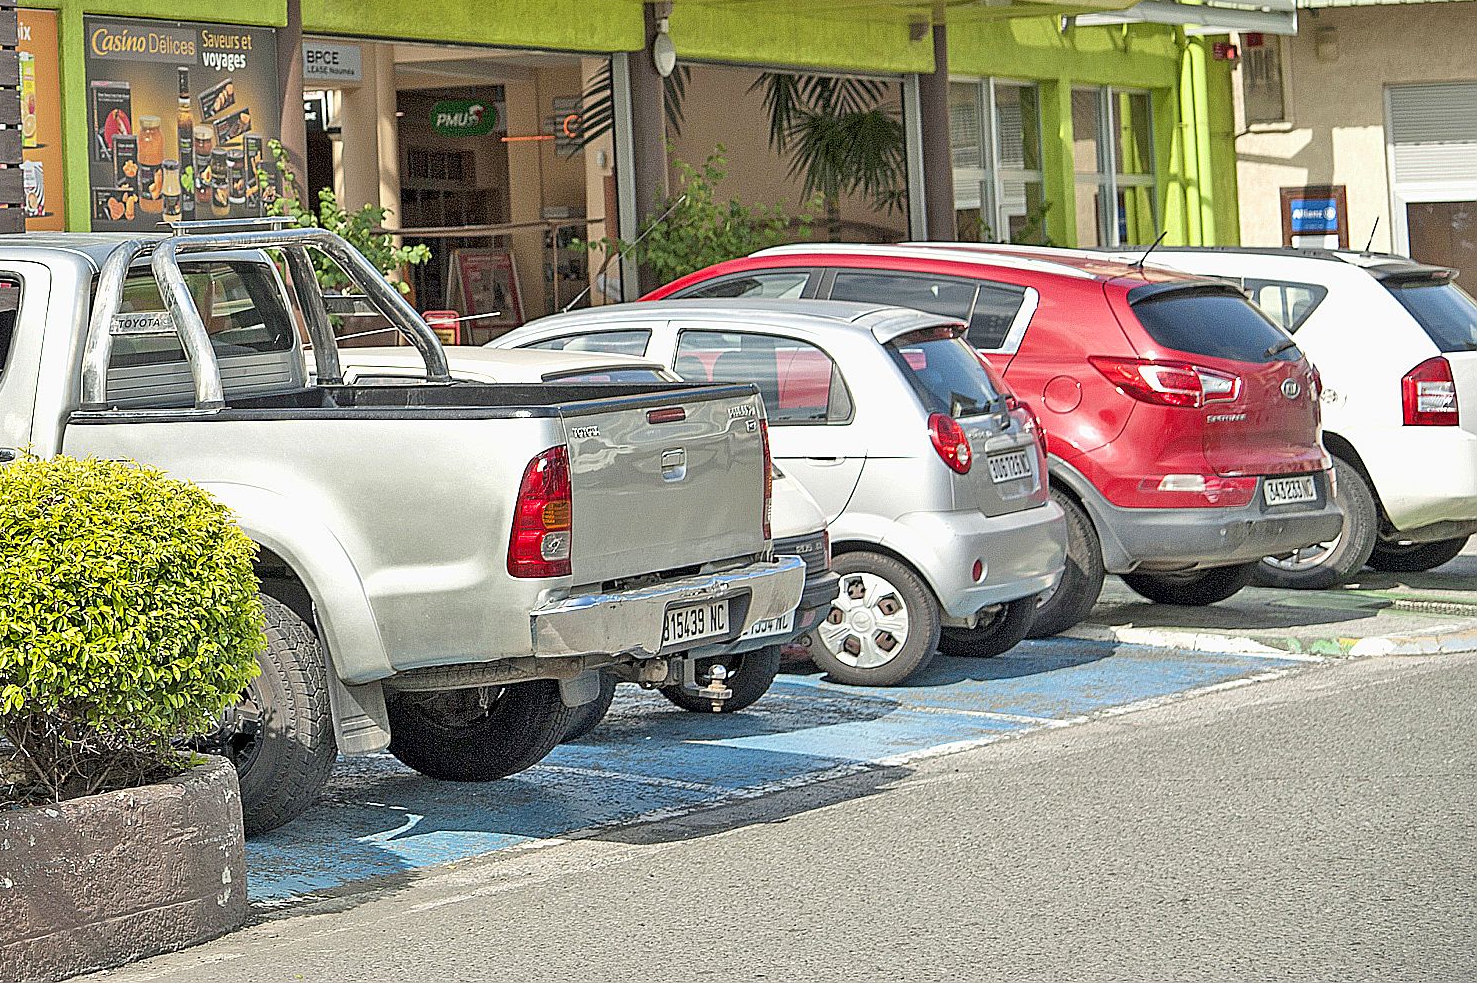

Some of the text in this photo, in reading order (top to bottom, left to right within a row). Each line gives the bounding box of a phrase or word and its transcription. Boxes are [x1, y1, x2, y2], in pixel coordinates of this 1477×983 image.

[18, 22, 31, 41] ix
[202, 30, 252, 50] Saveurs et
[91, 28, 195, 56] Casino Délices
[202, 51, 247, 72] voyages
[307, 50, 339, 65] BPCE
[437, 112, 468, 127] PMU
[118, 318, 160, 329] TOYOTA
[710, 604, 725, 632] NC
